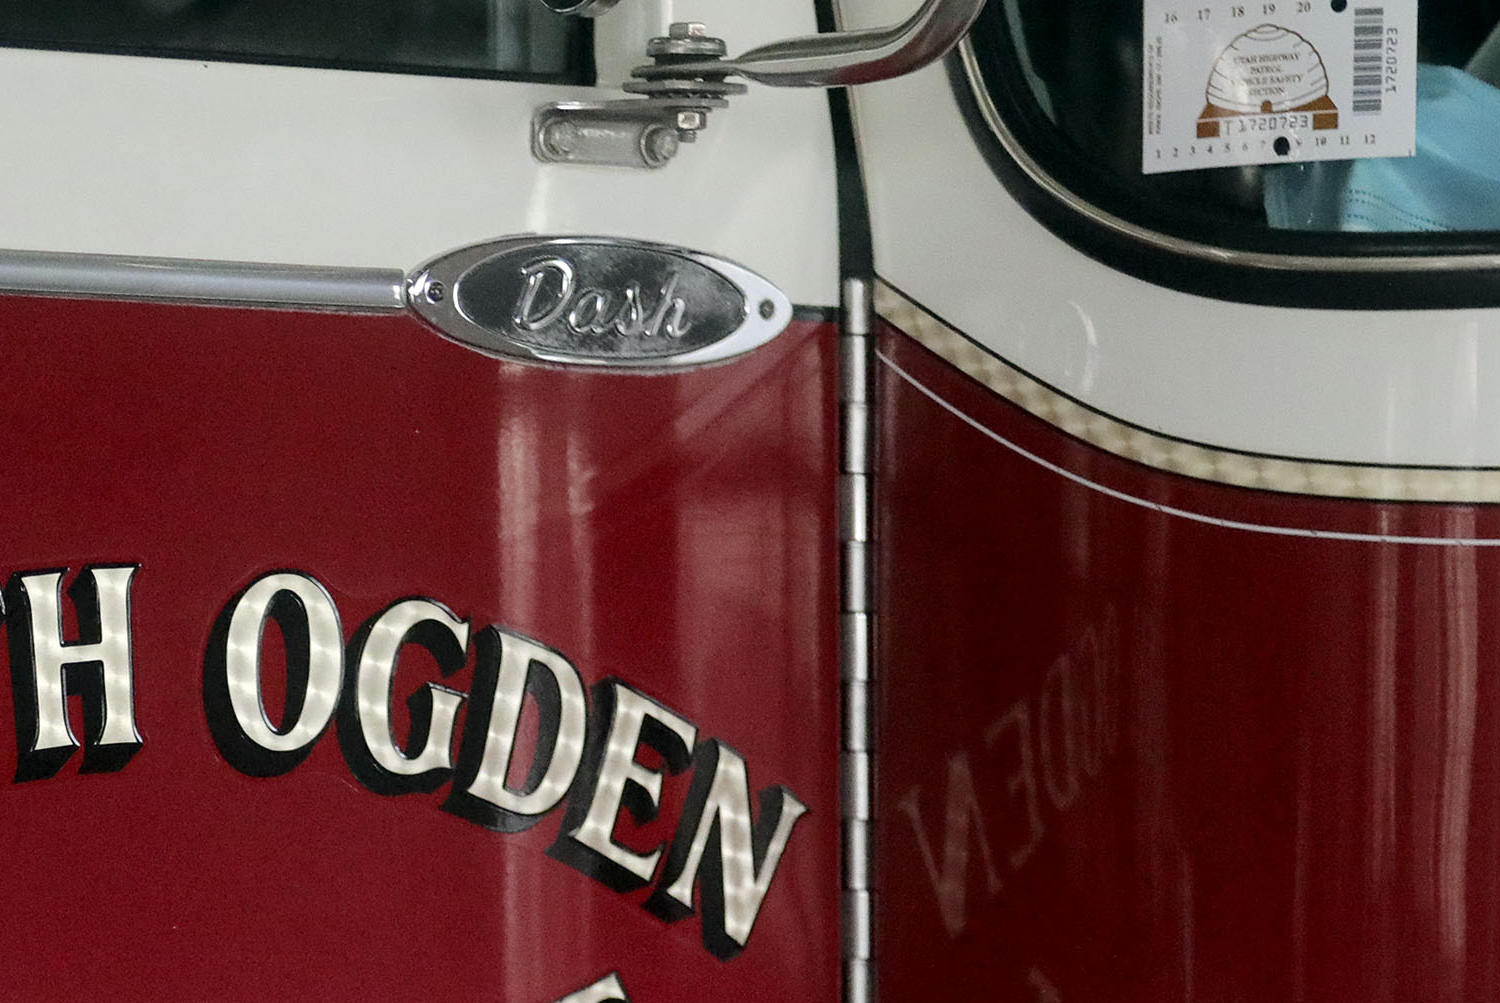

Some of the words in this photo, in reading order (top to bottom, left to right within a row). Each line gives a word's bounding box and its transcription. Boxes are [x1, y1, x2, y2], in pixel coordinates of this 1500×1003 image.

[1164, 12, 1178, 24] 16
[1197, 9, 1210, 21] 17
[1232, 6, 1245, 17] 18
[1263, 4, 1276, 15] 19
[1297, 2, 1310, 13] 20
[1385, 27, 1398, 93] 1720723
[1237, 115, 1309, 132] 1720723
[1316, 136, 1327, 146] 10
[1340, 134, 1350, 145] 11
[1365, 133, 1376, 144] 12
[514, 255, 696, 340] Dash
[208, 571, 809, 957] OGDEN
